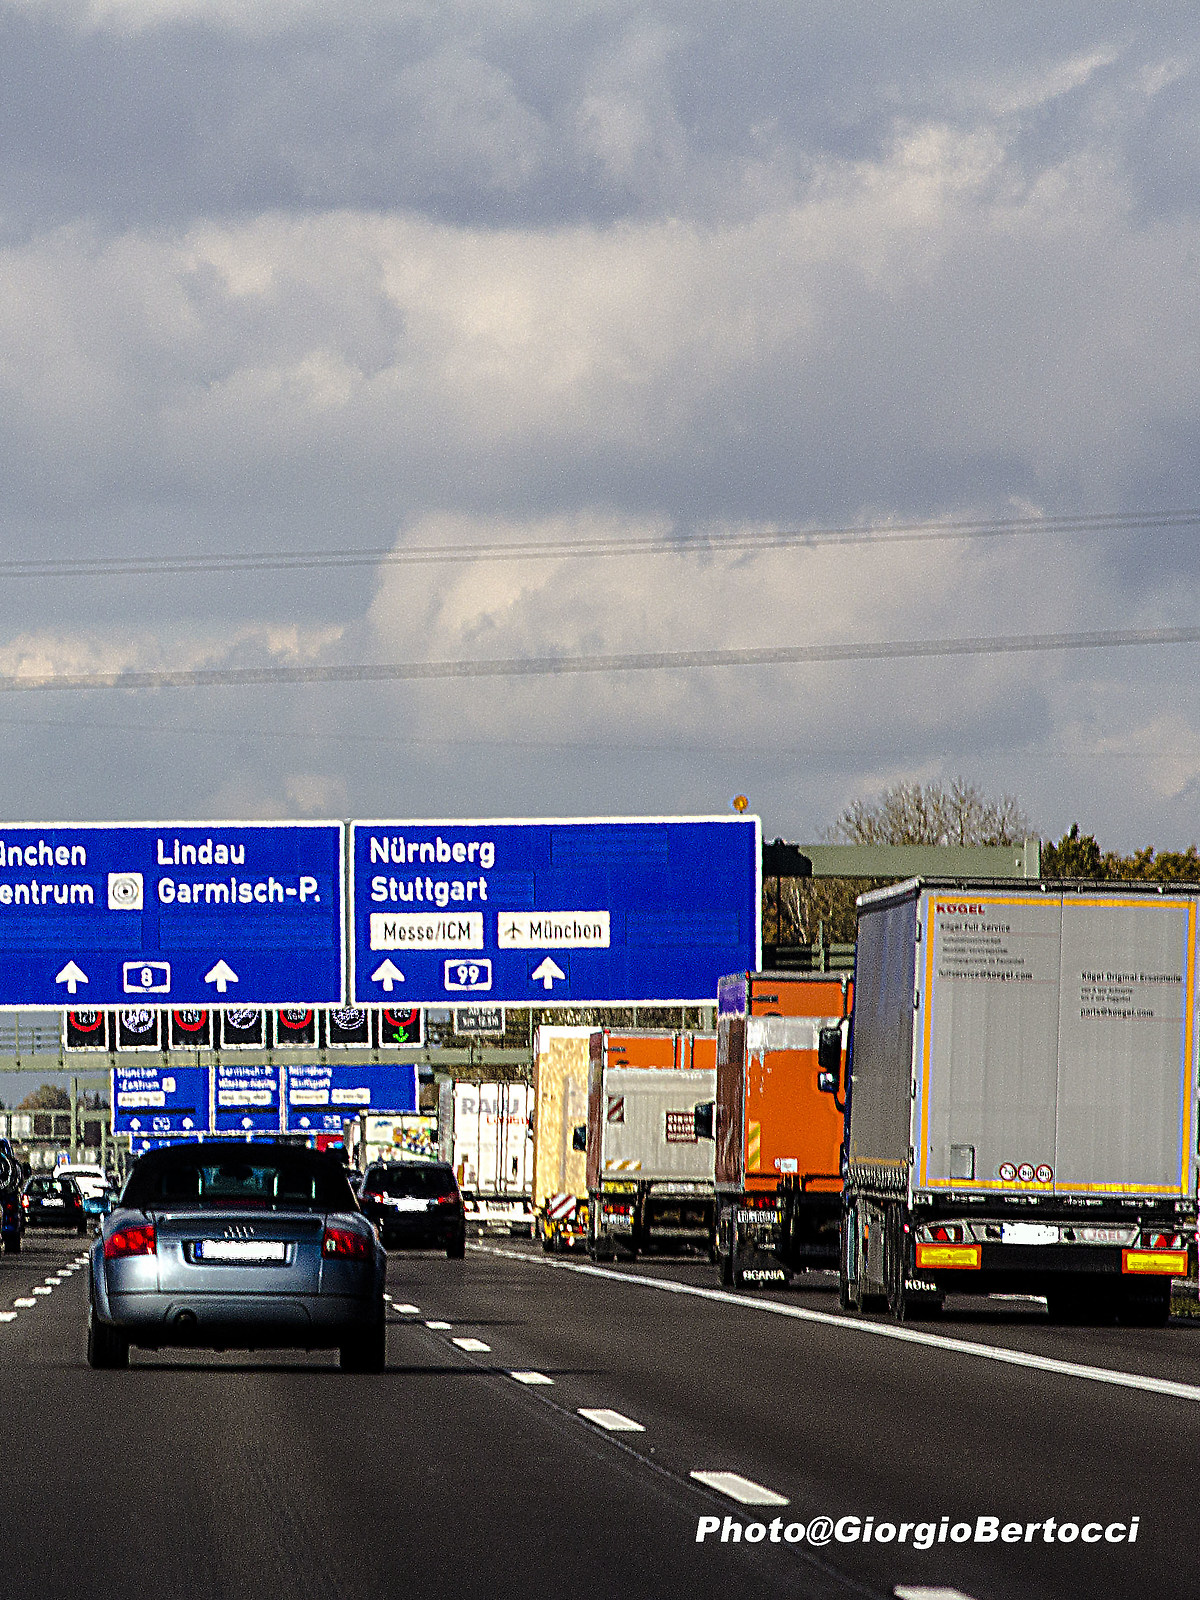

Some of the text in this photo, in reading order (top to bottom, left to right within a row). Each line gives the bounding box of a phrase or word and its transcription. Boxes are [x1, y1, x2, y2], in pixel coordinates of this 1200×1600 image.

[156, 838, 245, 866] Lindau
[369, 836, 495, 869] Nürnberg
[157, 875, 321, 904] Garmisch-P.
[370, 875, 488, 908] Stuttgart
[383, 922, 472, 941] Messe/ICM
[530, 921, 602, 939] München
[140, 967, 153, 987] 8
[456, 965, 480, 984] 99
